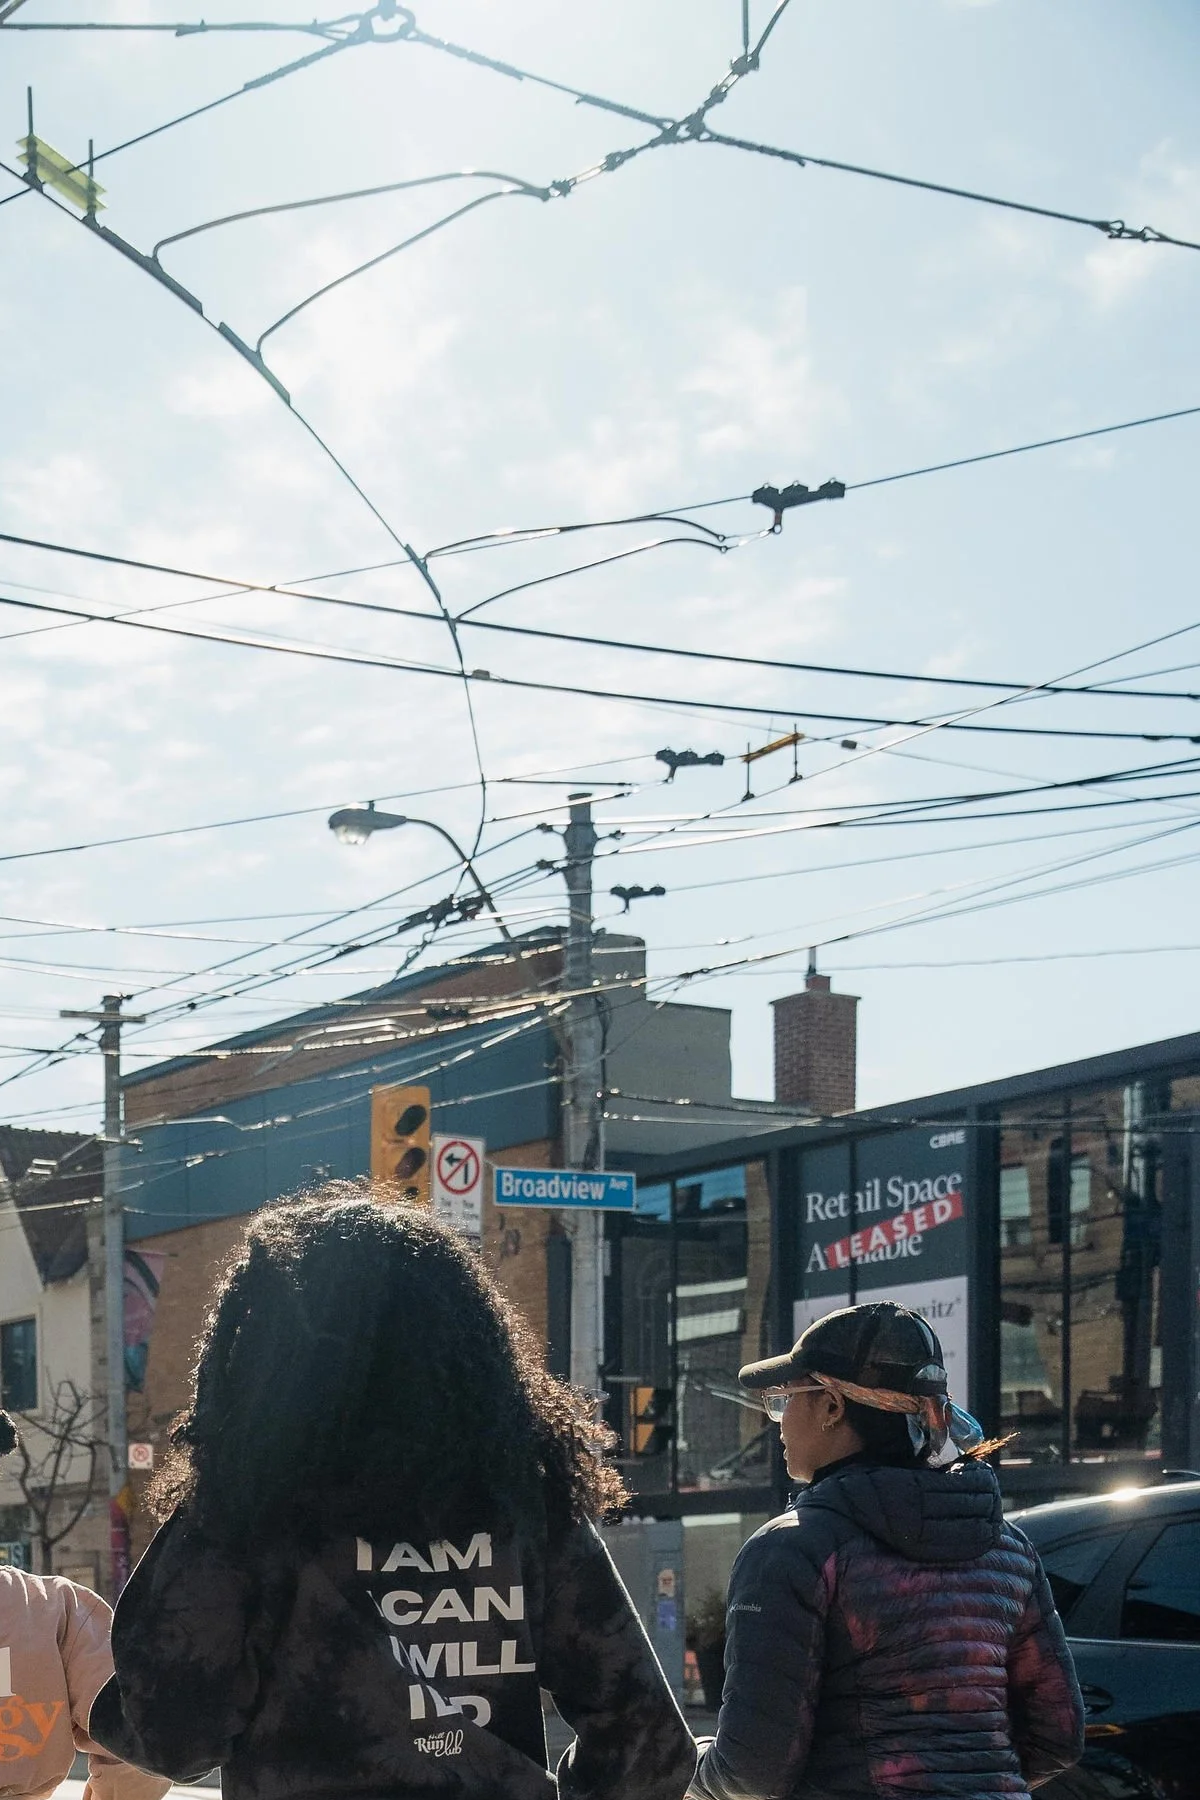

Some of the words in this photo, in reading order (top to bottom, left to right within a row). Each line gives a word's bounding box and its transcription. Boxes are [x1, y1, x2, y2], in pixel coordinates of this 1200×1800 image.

[502, 1172, 605, 1200] Broadview
[609, 1178, 628, 1191] Ave
[886, 1172, 963, 1213] Space
[834, 1199, 953, 1266] LEASED
[356, 1536, 372, 1571] I
[380, 1532, 492, 1573] AM
[734, 1602, 762, 1613] Columbia
[400, 1640, 536, 1678] WILL
[413, 1737, 444, 1754] Run
